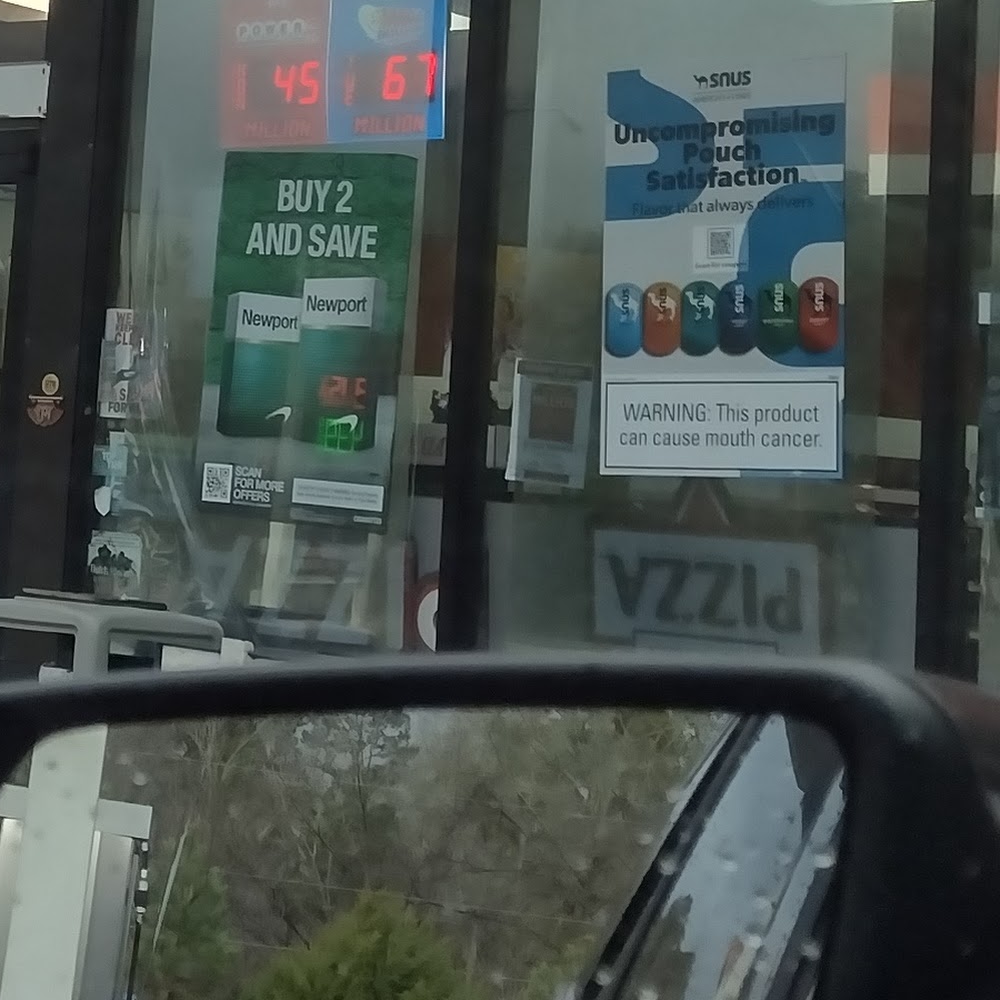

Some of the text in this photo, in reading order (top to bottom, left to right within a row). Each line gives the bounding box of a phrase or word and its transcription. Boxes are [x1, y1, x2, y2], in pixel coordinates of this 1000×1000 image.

[273, 60, 319, 105] 45
[381, 51, 438, 101] 67
[354, 114, 425, 134] MILLION
[614, 109, 836, 145] Uncompromising
[683, 139, 762, 164] Pouch
[277, 179, 354, 213] BUY 2
[706, 199, 754, 217] always
[246, 222, 378, 259] AND SAVE
[306, 294, 368, 315] Newport
[242, 309, 299, 331] Newport
[623, 403, 819, 427] WARNING: This product
[620, 428, 823, 448] can cause mouth cancer.
[235, 465, 263, 479] SCAN
[232, 490, 271, 503] OFFERS
[233, 477, 255, 491] FOR
[256, 479, 285, 494] MORE
[606, 553, 803, 633] PIZZA
